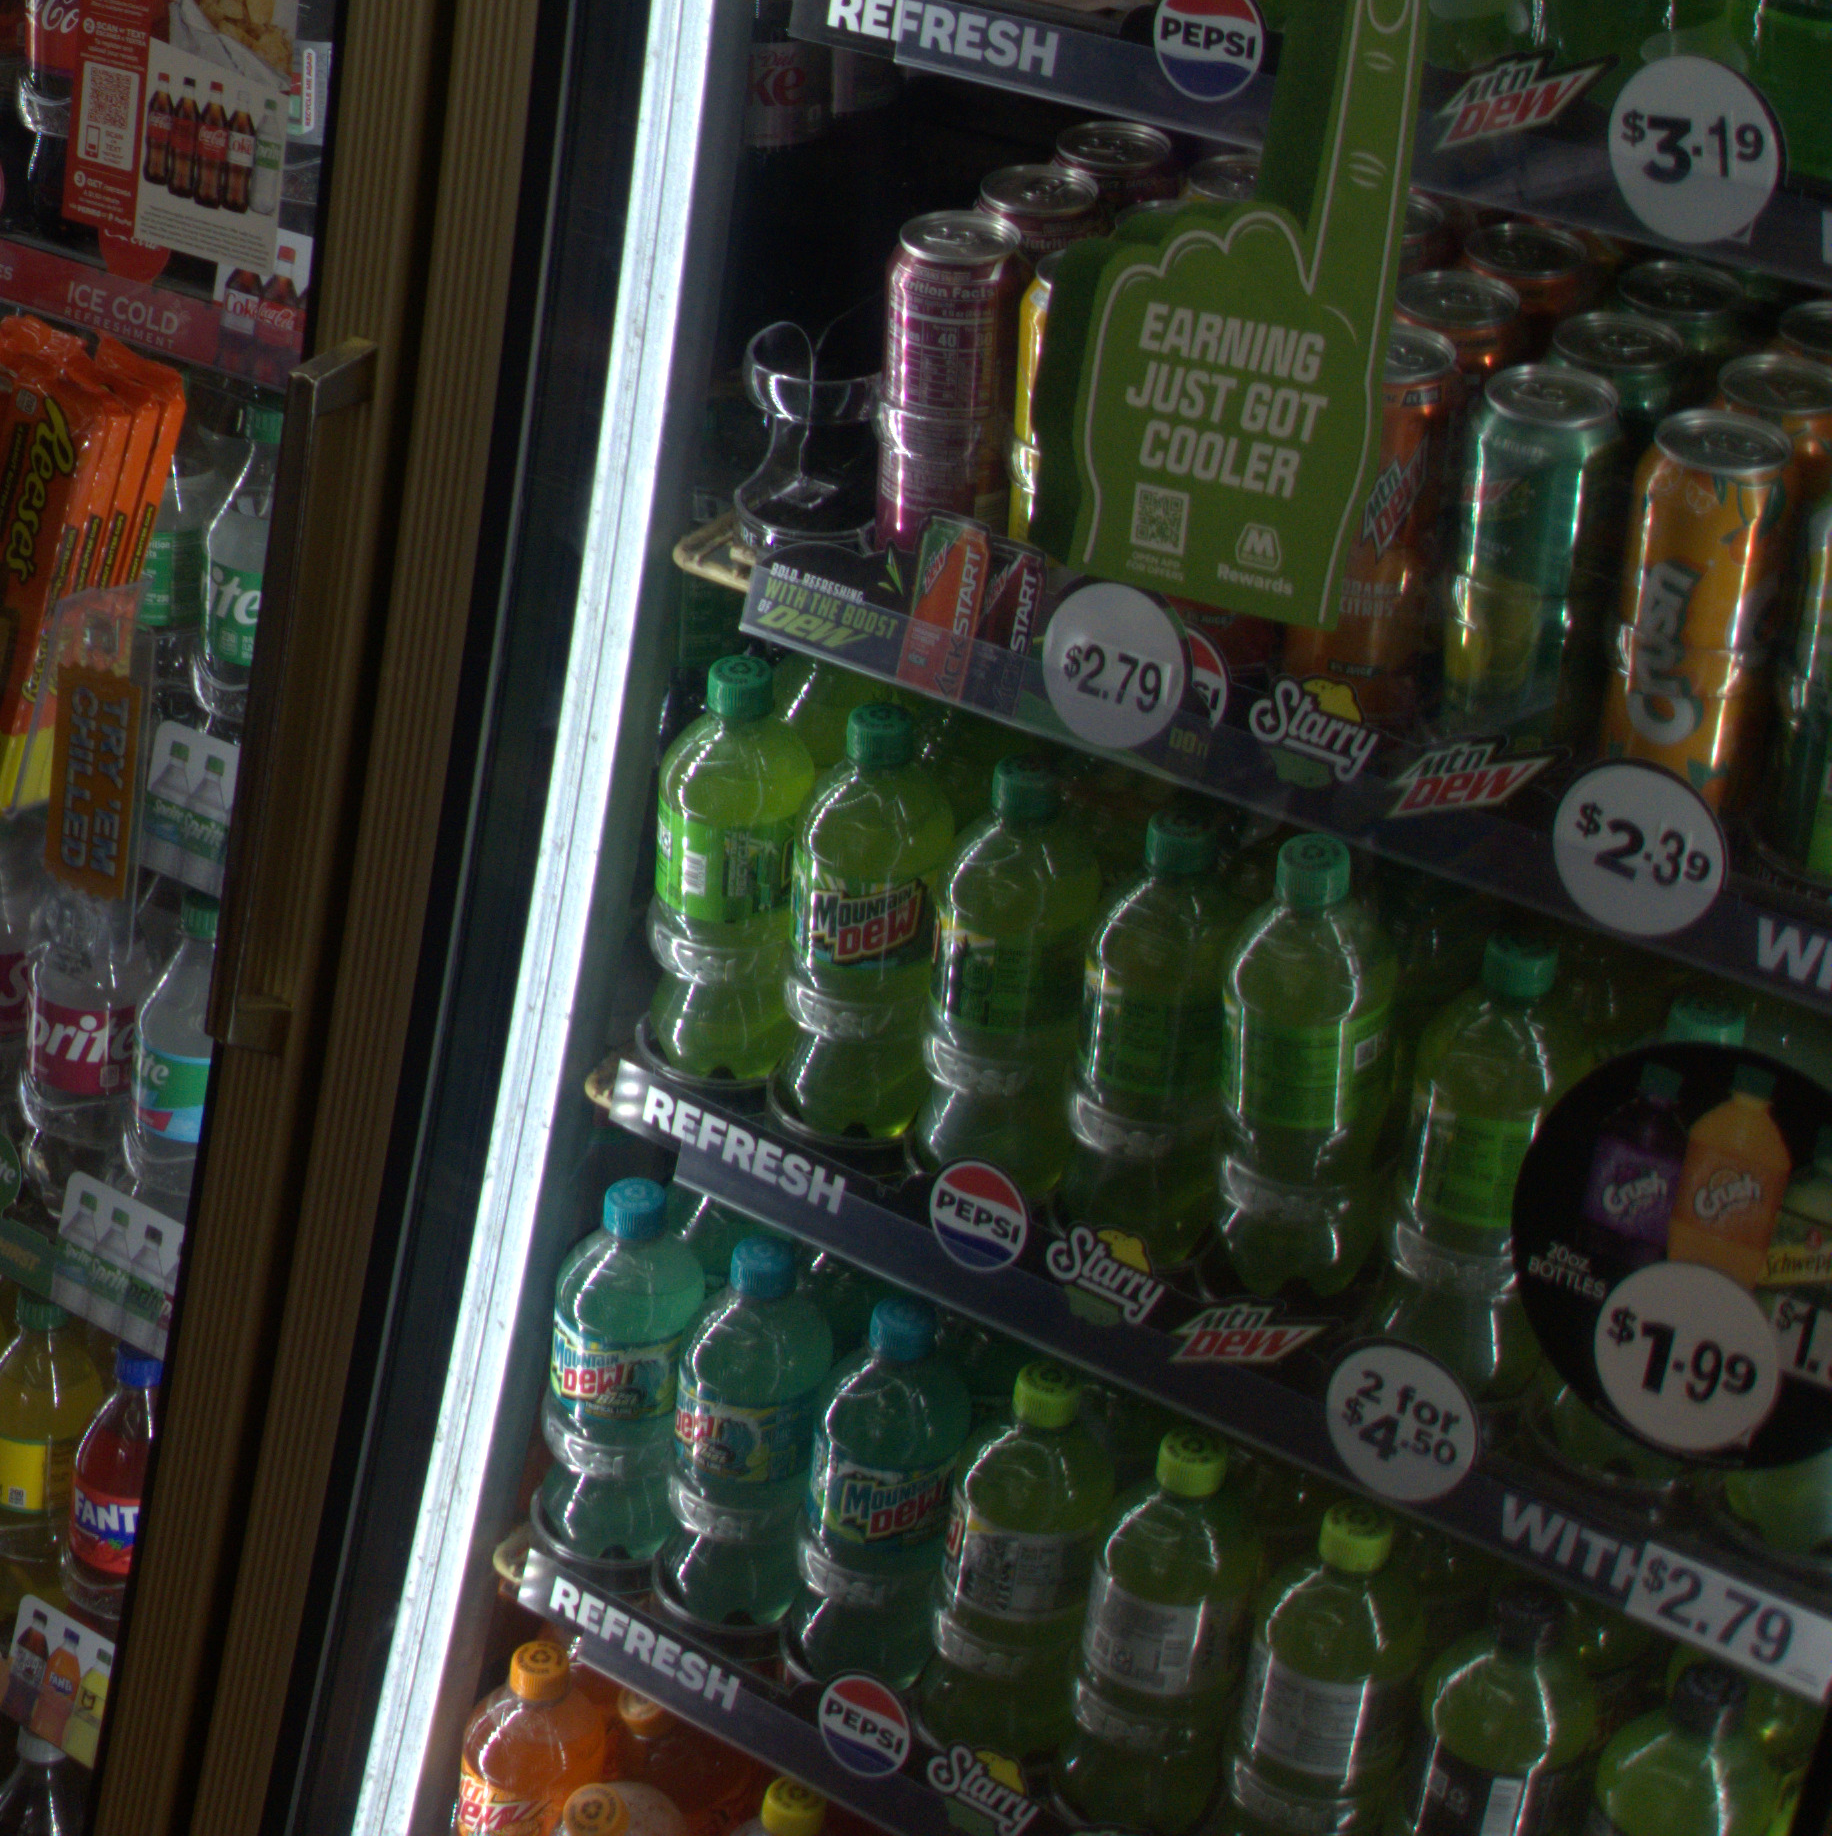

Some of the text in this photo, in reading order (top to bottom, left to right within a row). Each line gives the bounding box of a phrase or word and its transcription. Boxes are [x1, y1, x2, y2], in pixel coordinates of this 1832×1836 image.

[1160, 15, 1257, 62] PEPSI
[1623, 109, 1766, 183] $3.19
[64, 306, 174, 349] REFRESHMENT
[67, 280, 178, 335] ICE COLD
[1139, 302, 1326, 384] EARNING
[1125, 361, 1328, 443] JUST GOT
[5, 397, 74, 583] Reese's
[1139, 420, 1302, 500] COOLER
[764, 578, 899, 641] WITH THE BOOST
[1217, 563, 1294, 597] Rewards
[1063, 643, 1164, 713] $2.79
[1249, 677, 1378, 782] Starry
[60, 686, 101, 868] CHILLED
[1577, 802, 1712, 887] $2.39
[644, 1086, 845, 1213] REFRESH
[937, 1188, 1021, 1245] PEPSI
[1601, 1171, 1667, 1216] Crush
[1694, 1171, 1762, 1221] Crush
[1046, 1227, 1164, 1323] Starry
[1529, 1255, 1607, 1300] BOTTLES
[1607, 1306, 1757, 1404] $1.99
[1342, 1398, 1457, 1466] $4.50
[1361, 1370, 1460, 1429] 2 for
[550, 1576, 740, 1712] REFRESH
[1642, 1556, 1793, 1667] $2.79
[825, 1695, 904, 1756] PEPSI
